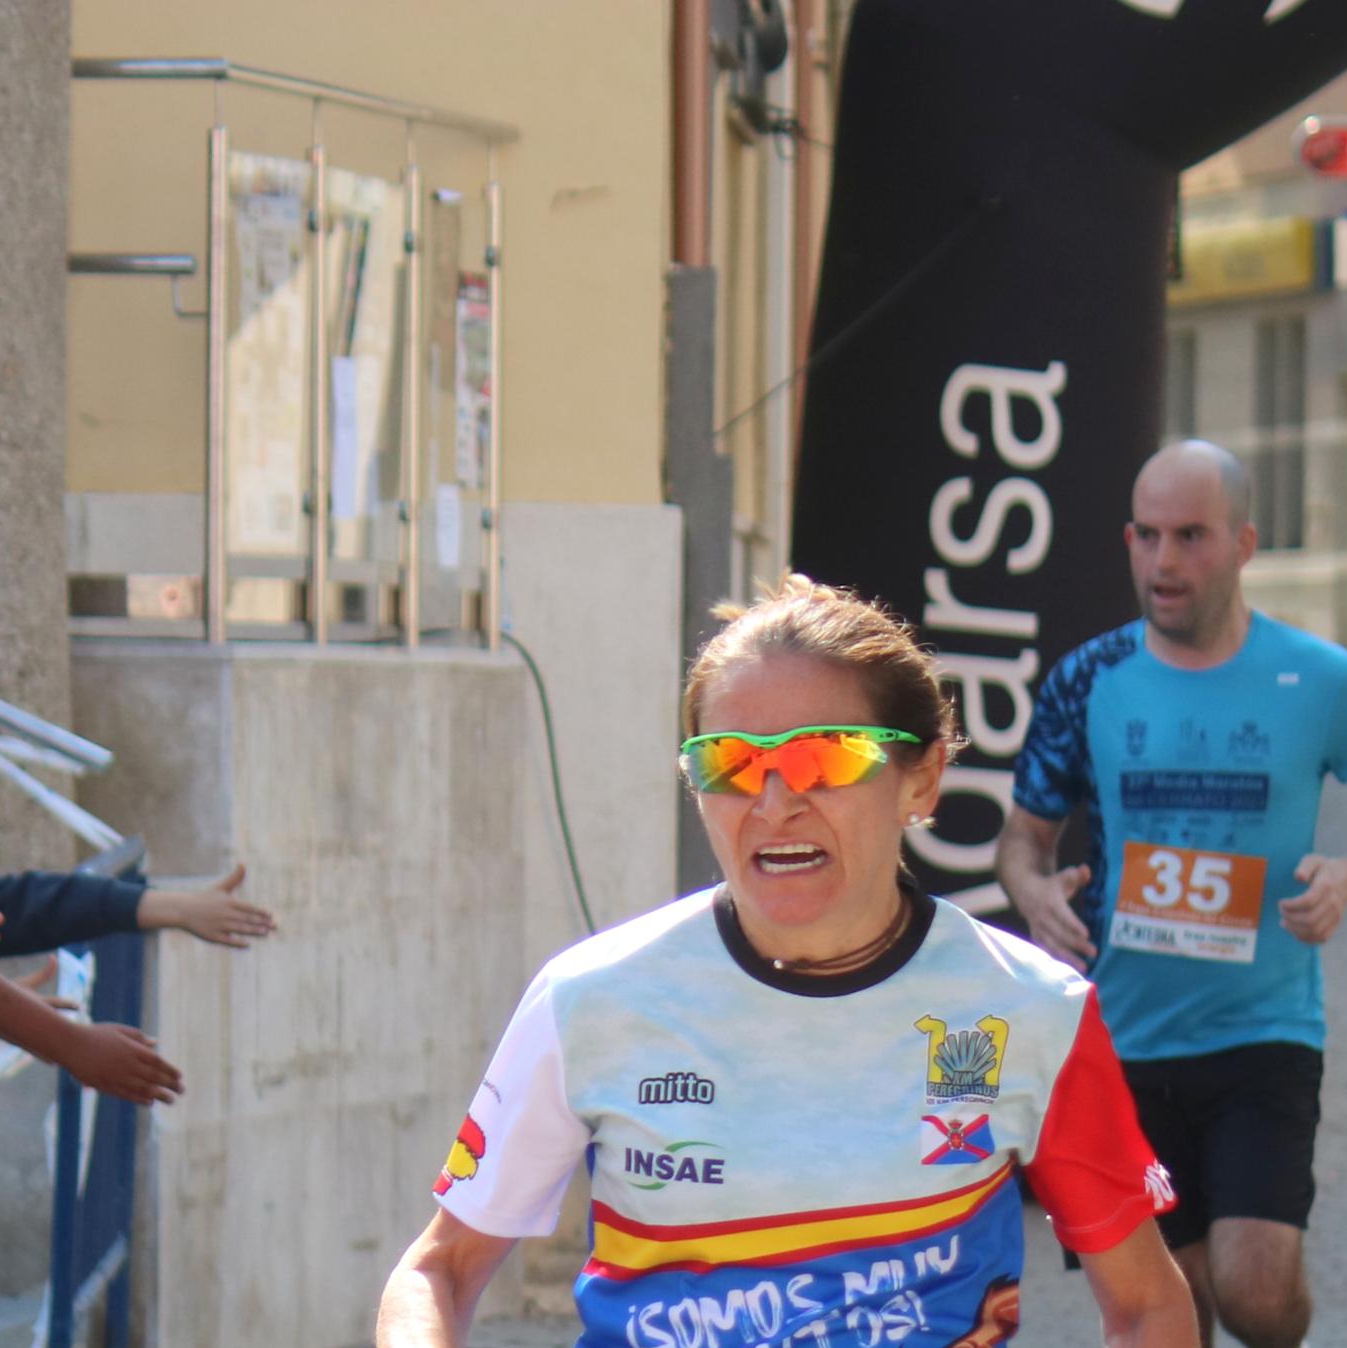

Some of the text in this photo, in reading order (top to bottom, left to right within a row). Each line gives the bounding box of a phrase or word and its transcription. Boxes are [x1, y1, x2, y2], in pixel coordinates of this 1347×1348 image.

[1141, 848, 1234, 914] 35
[638, 1071, 715, 1105] mitto
[624, 1147, 725, 1185] INSAE
